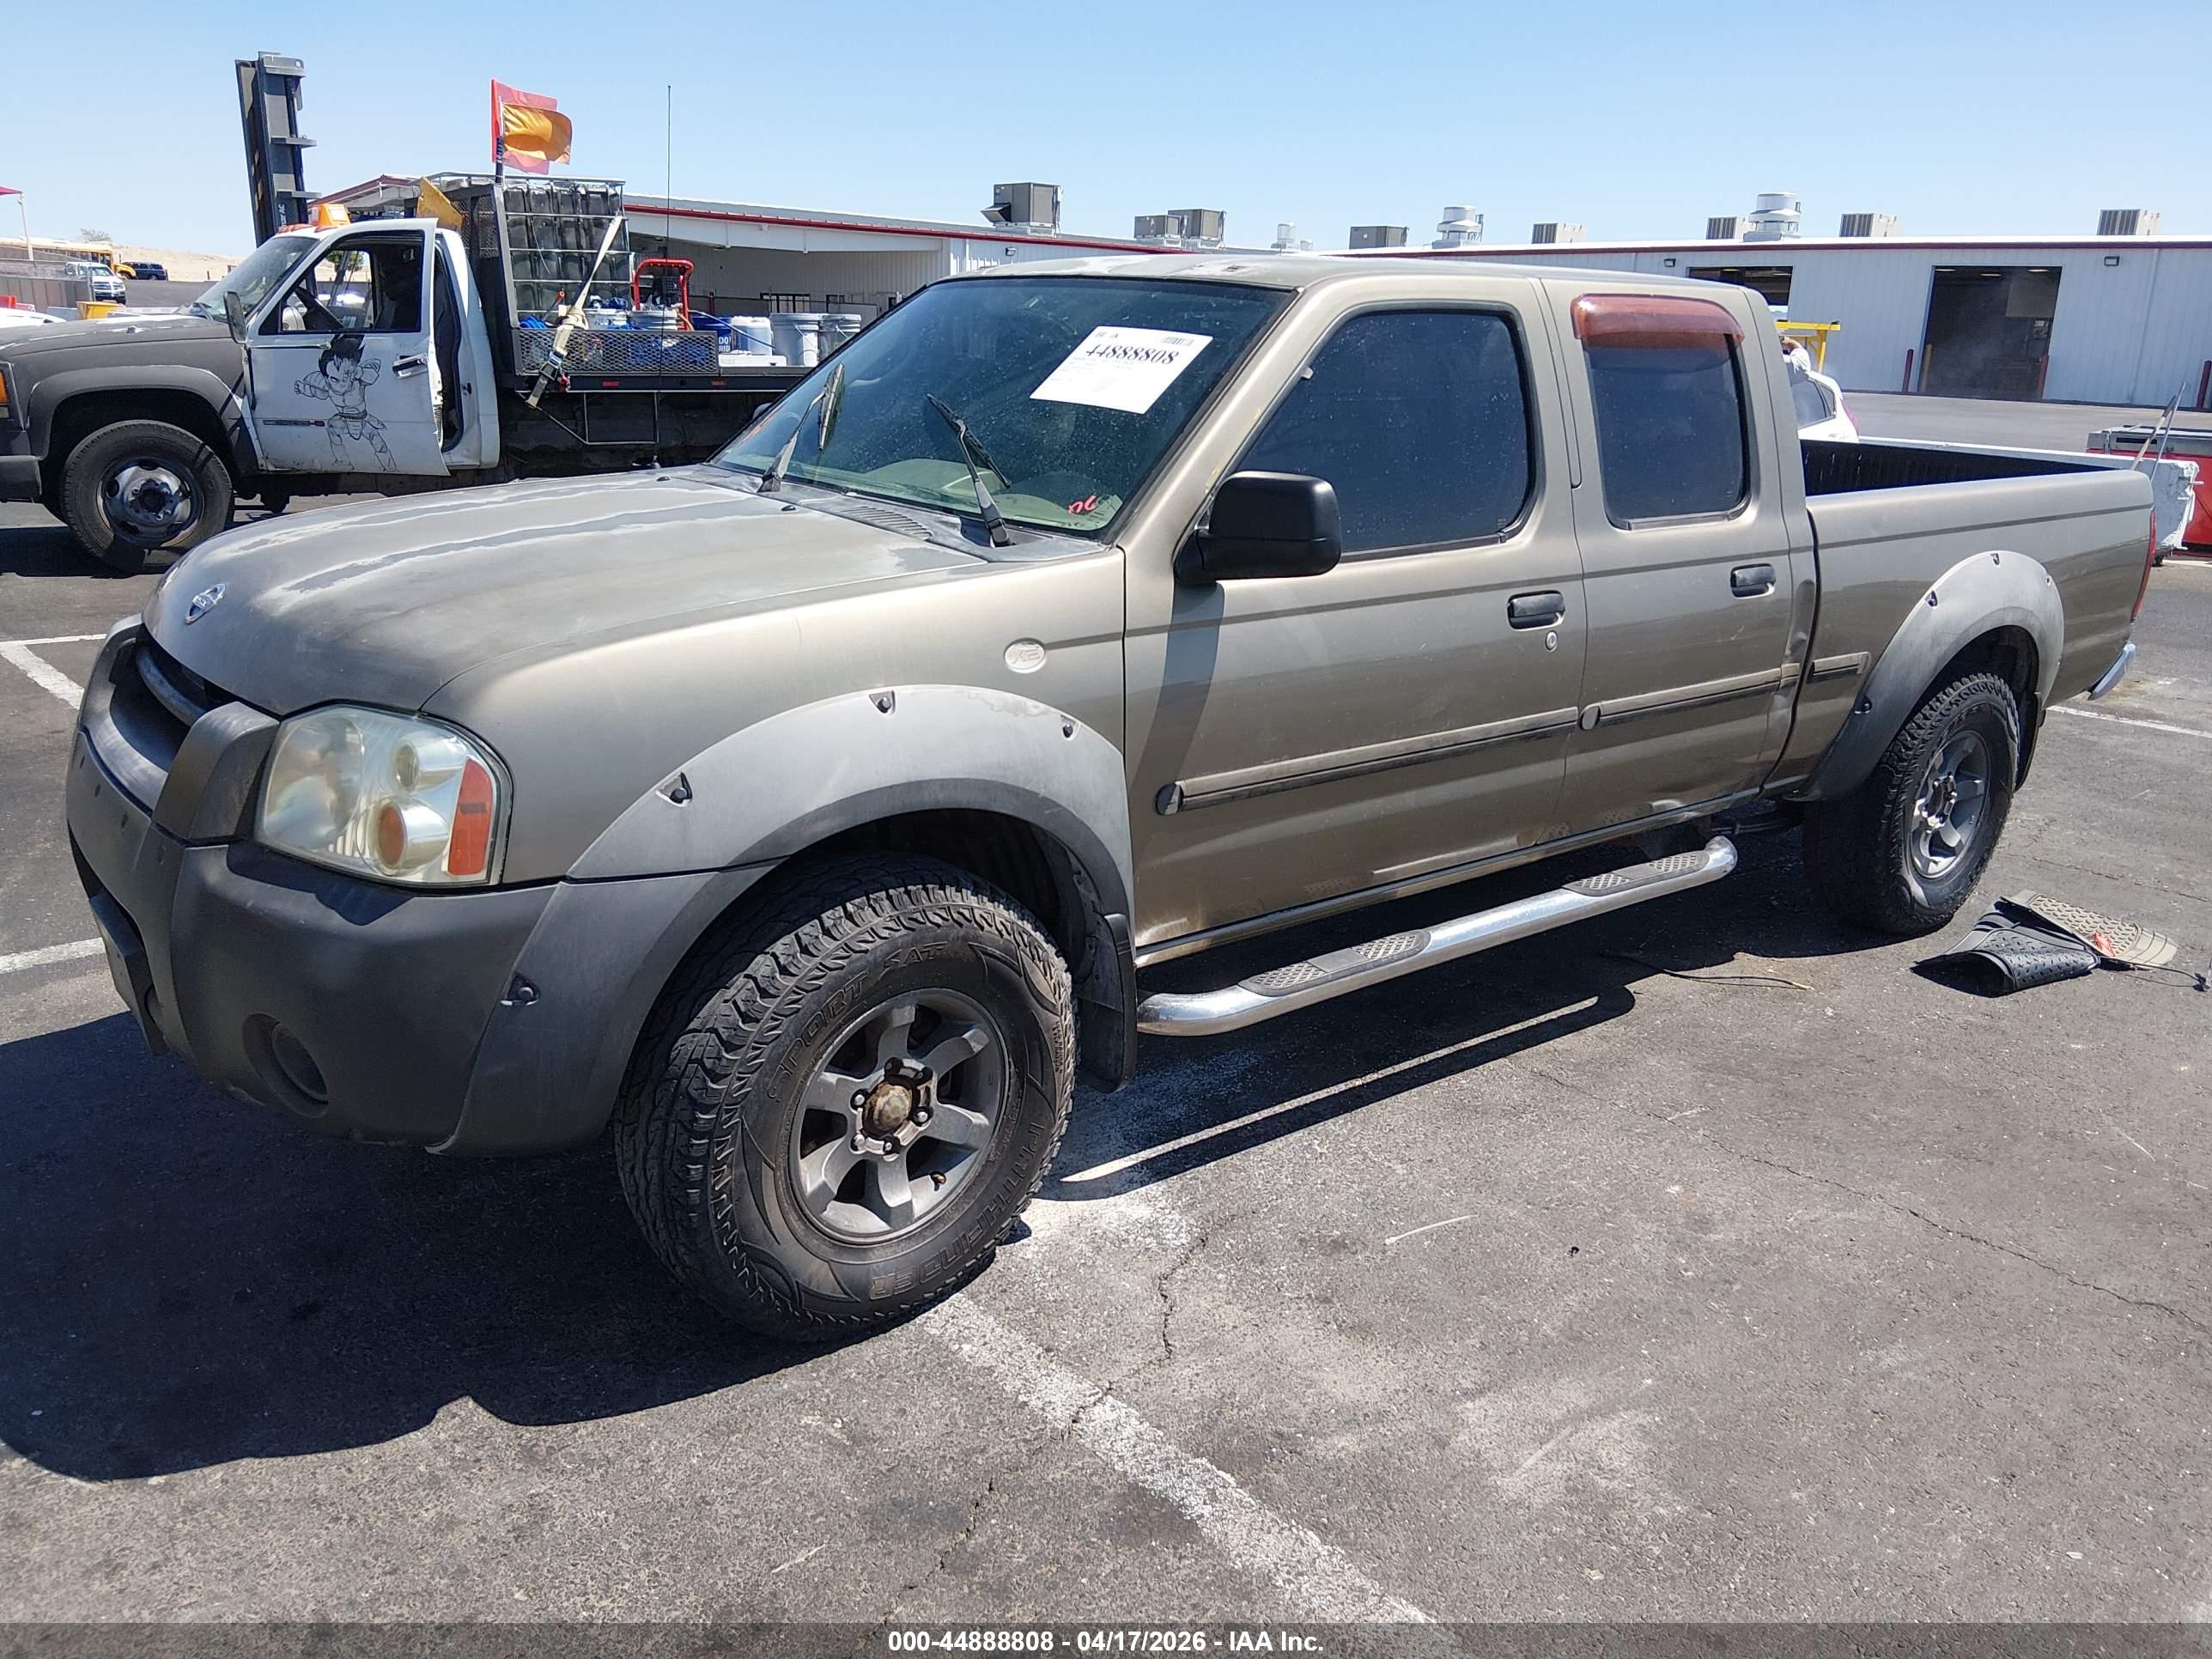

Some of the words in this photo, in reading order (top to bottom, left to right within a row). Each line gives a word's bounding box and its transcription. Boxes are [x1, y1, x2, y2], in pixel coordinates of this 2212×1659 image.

[1085, 343, 1180, 365] 44888808
[767, 971, 869, 1099] SPORT
[869, 1121, 1045, 1301] PATHFINDER
